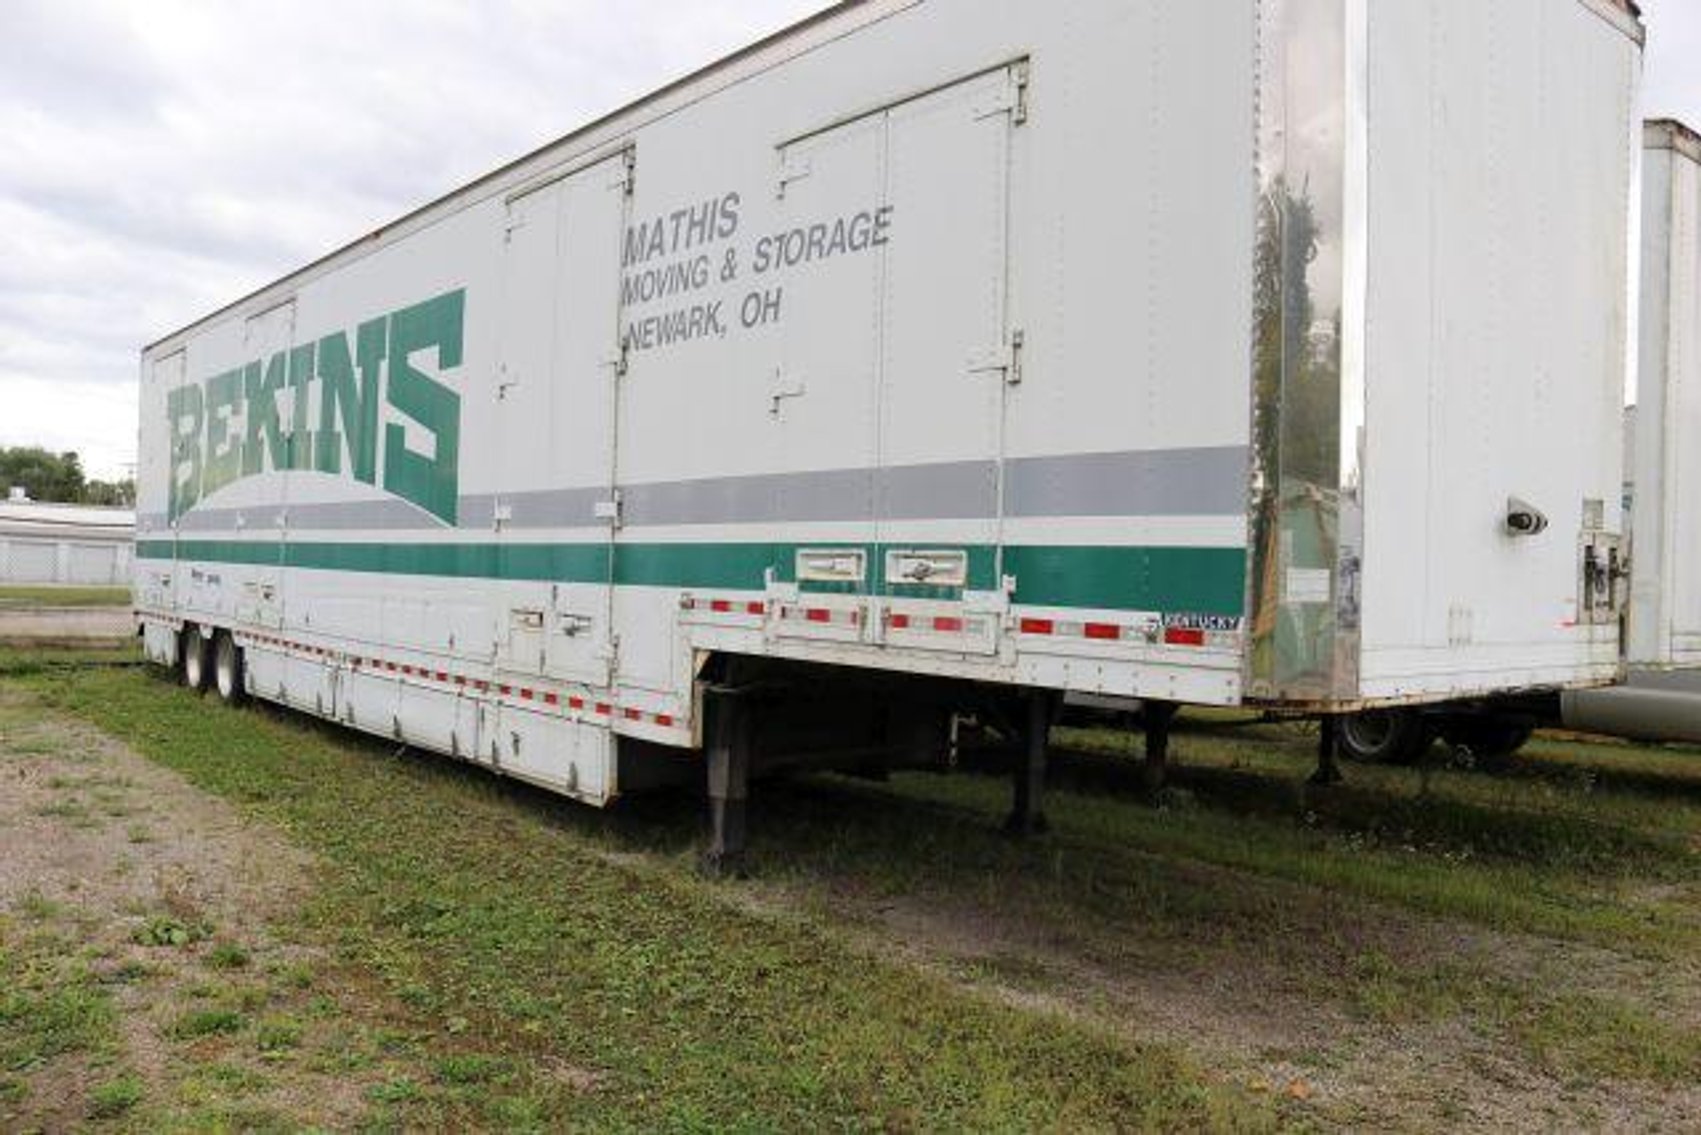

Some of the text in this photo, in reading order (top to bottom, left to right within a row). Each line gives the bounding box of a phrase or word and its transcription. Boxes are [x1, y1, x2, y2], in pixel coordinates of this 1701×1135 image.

[621, 191, 740, 269] MATHIS
[622, 205, 894, 307] MOVING & STORAGE
[626, 287, 782, 351] NEWARK, OH
[167, 287, 465, 528] BEKINS
